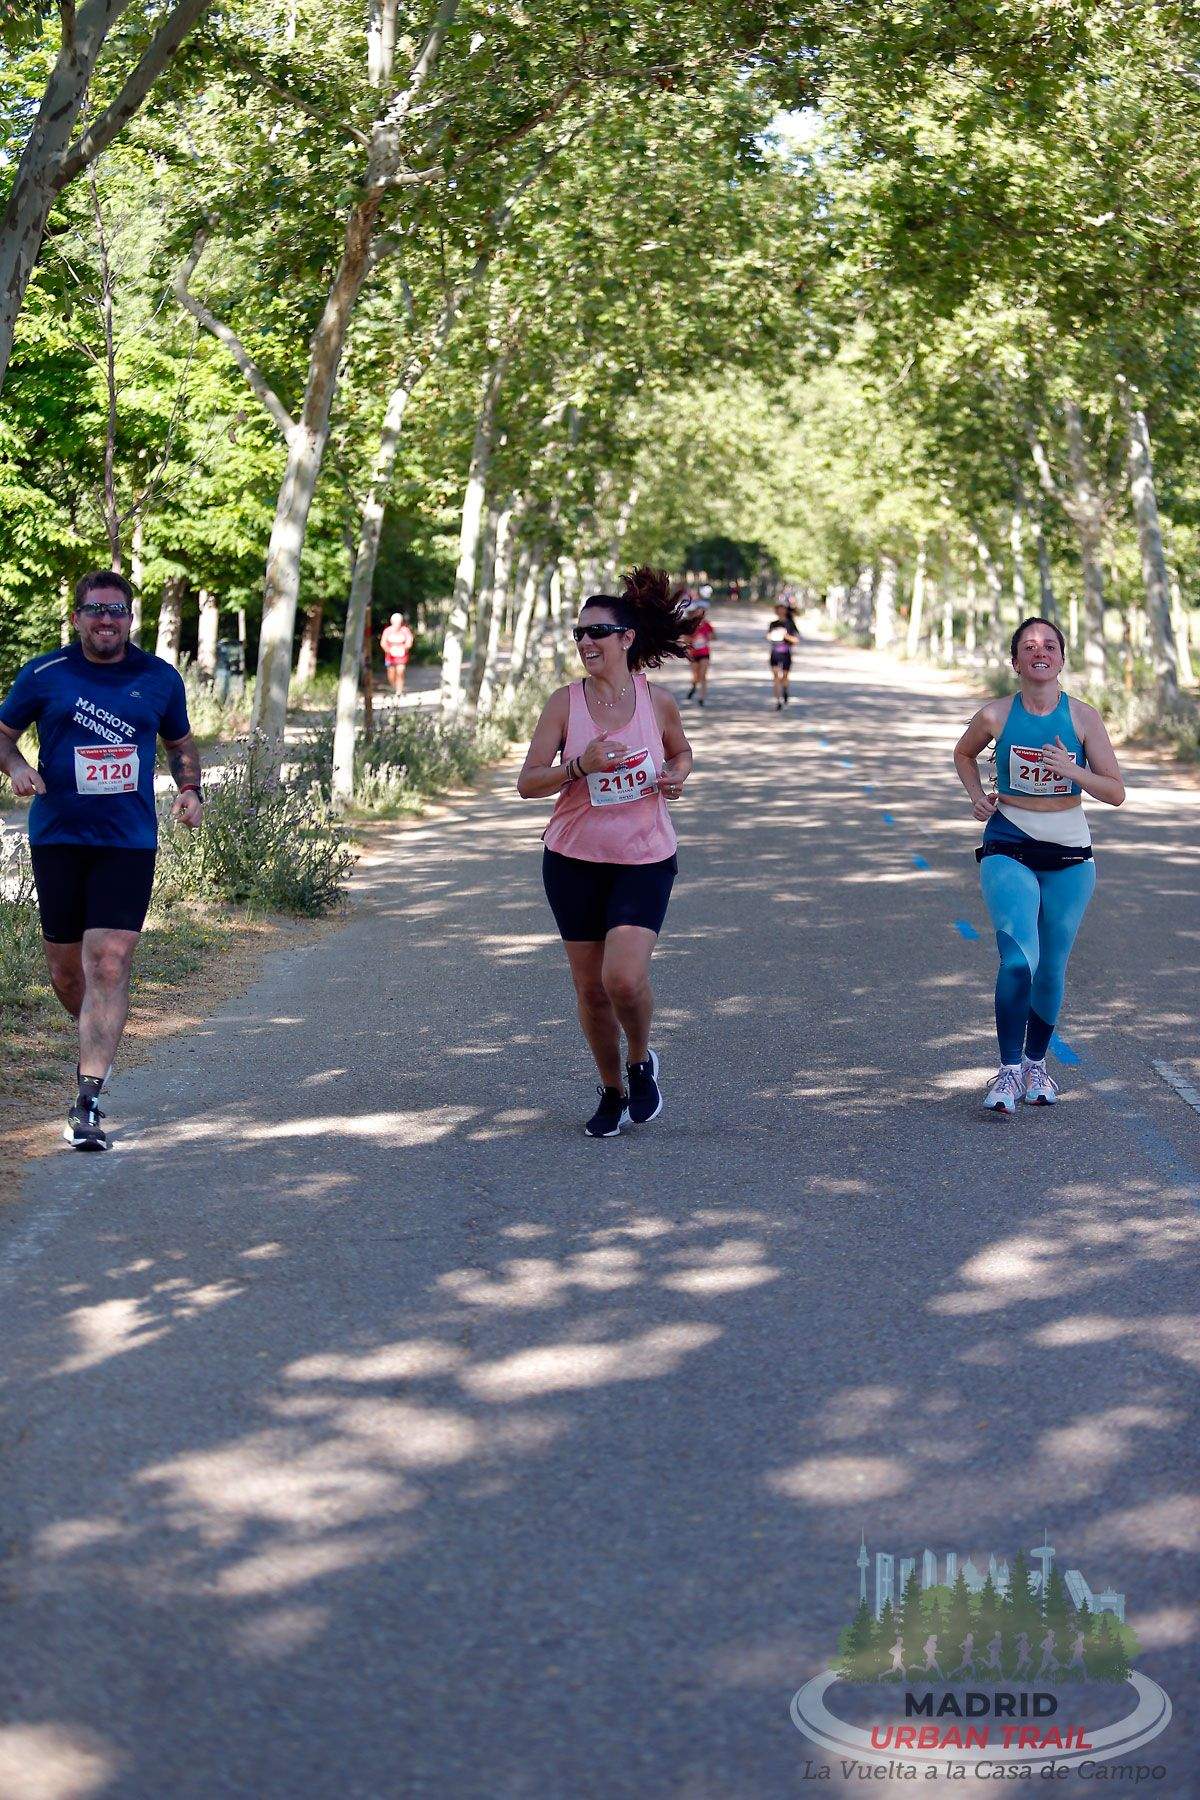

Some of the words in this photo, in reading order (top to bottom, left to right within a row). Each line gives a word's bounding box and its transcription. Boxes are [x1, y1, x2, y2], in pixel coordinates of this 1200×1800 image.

[73, 711, 123, 745] RUNNER
[75, 696, 136, 738] MACHOTE
[86, 763, 132, 781] 2120
[598, 770, 647, 793] 2119
